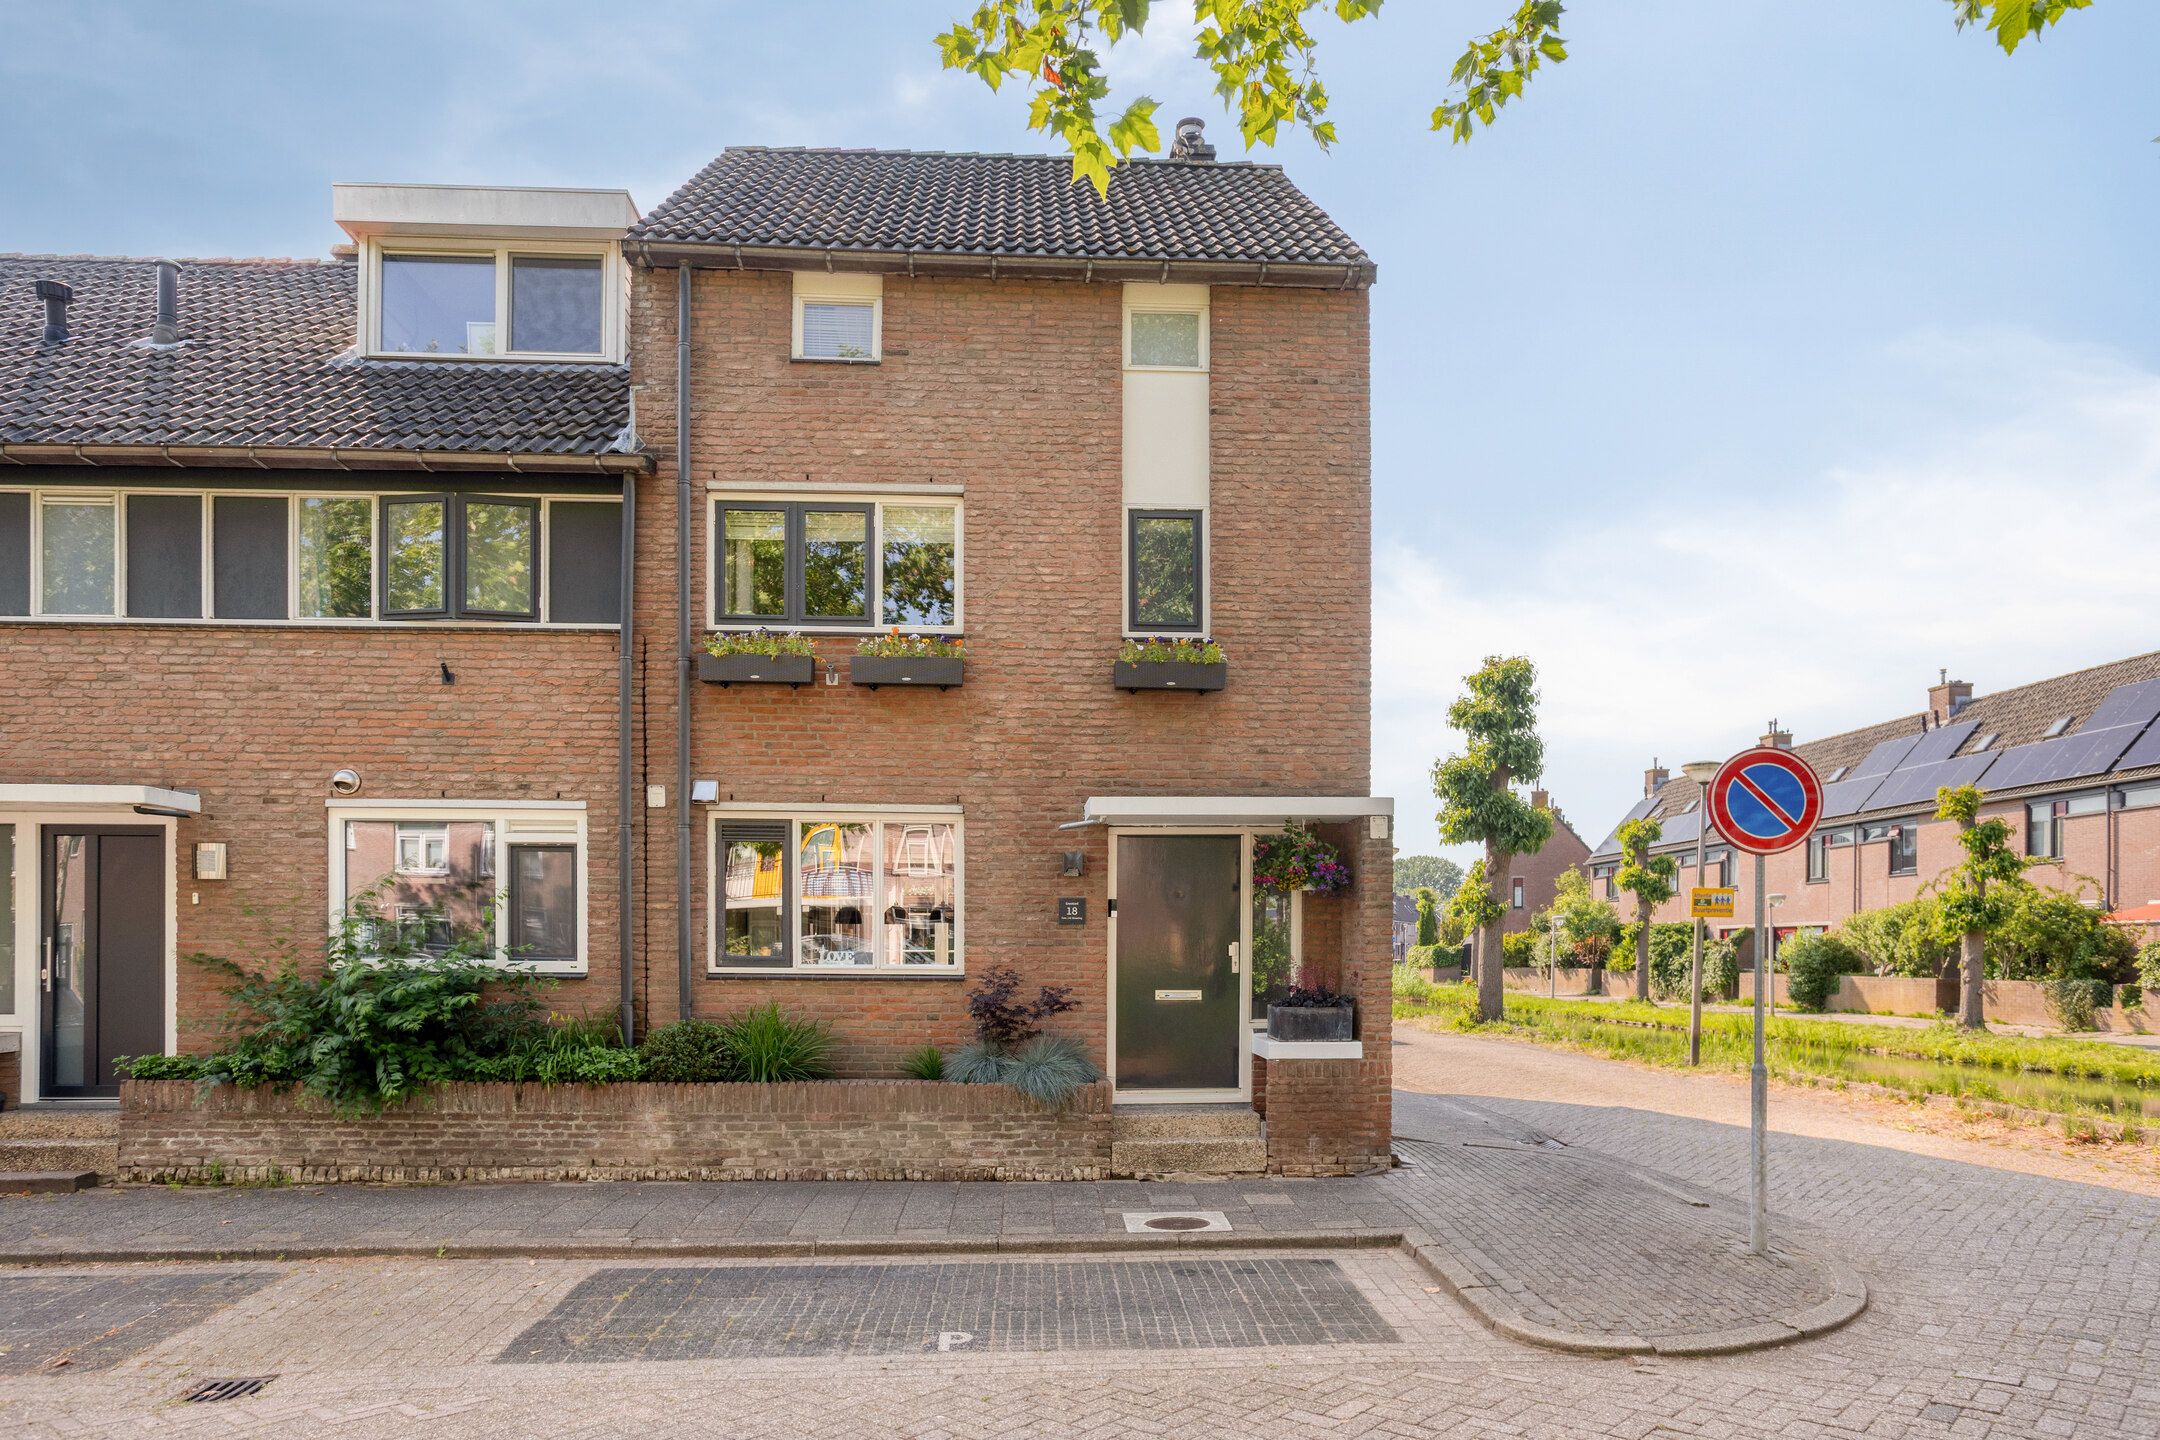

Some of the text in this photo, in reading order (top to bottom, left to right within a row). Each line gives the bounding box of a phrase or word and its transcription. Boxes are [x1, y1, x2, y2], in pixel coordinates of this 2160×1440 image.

[1066, 907, 1078, 915] 18
[820, 950, 855, 961] LOVE
[938, 1332, 974, 1351] P
